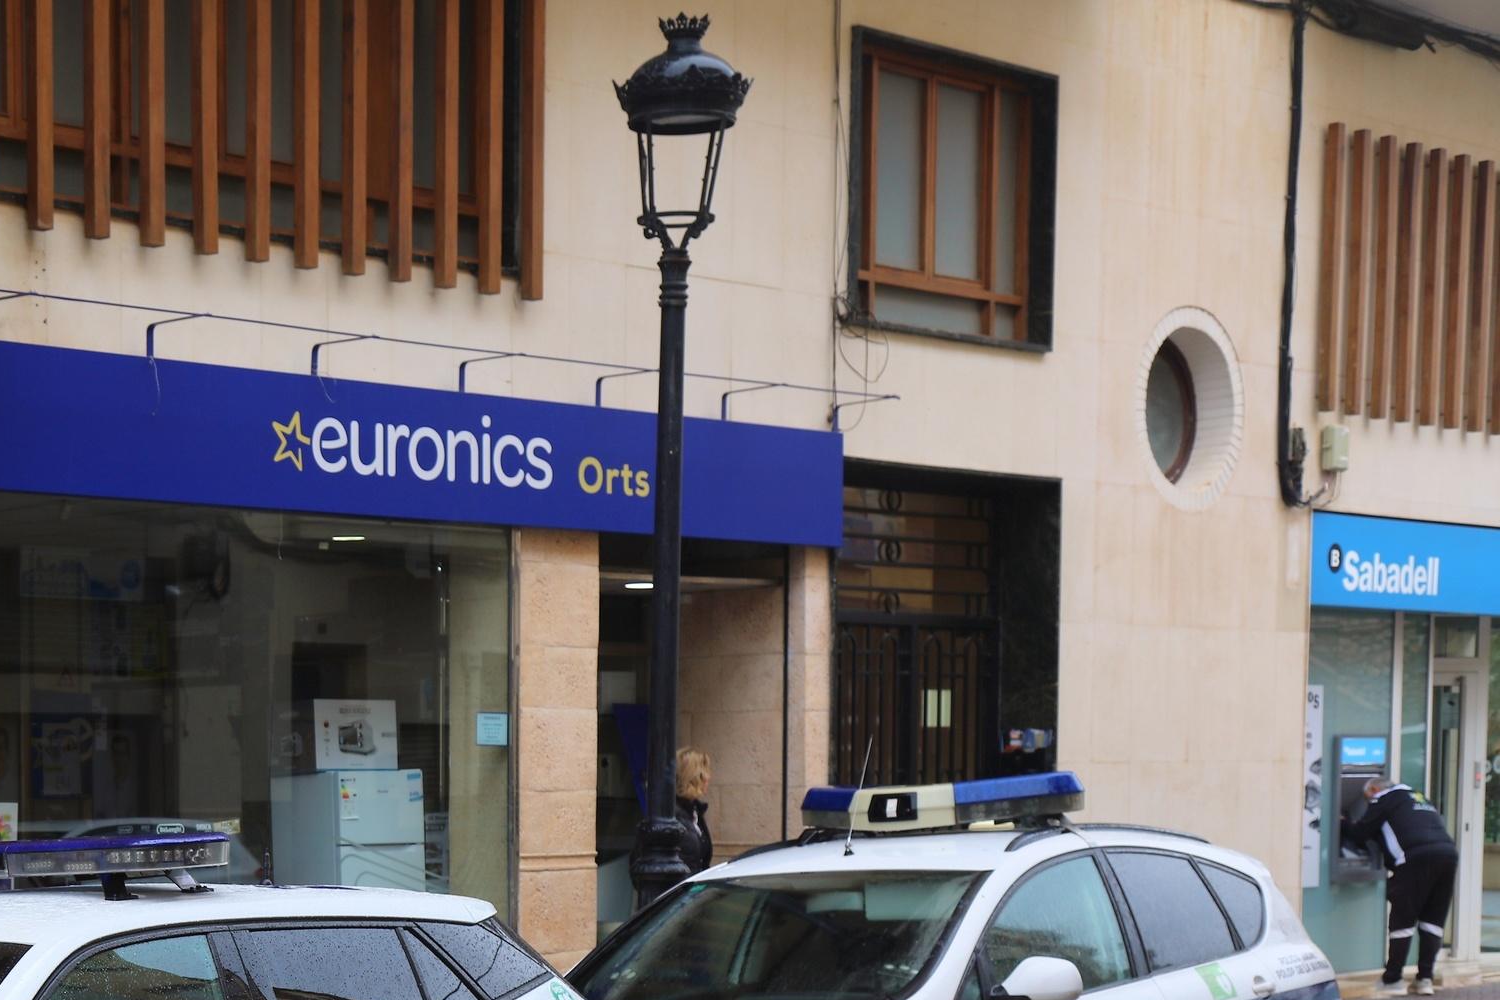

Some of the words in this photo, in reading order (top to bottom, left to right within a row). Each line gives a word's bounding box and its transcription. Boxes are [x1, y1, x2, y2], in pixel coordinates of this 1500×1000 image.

[311, 414, 553, 490] euronics
[577, 456, 650, 498] Orts
[1342, 550, 1440, 596] Sabadell
